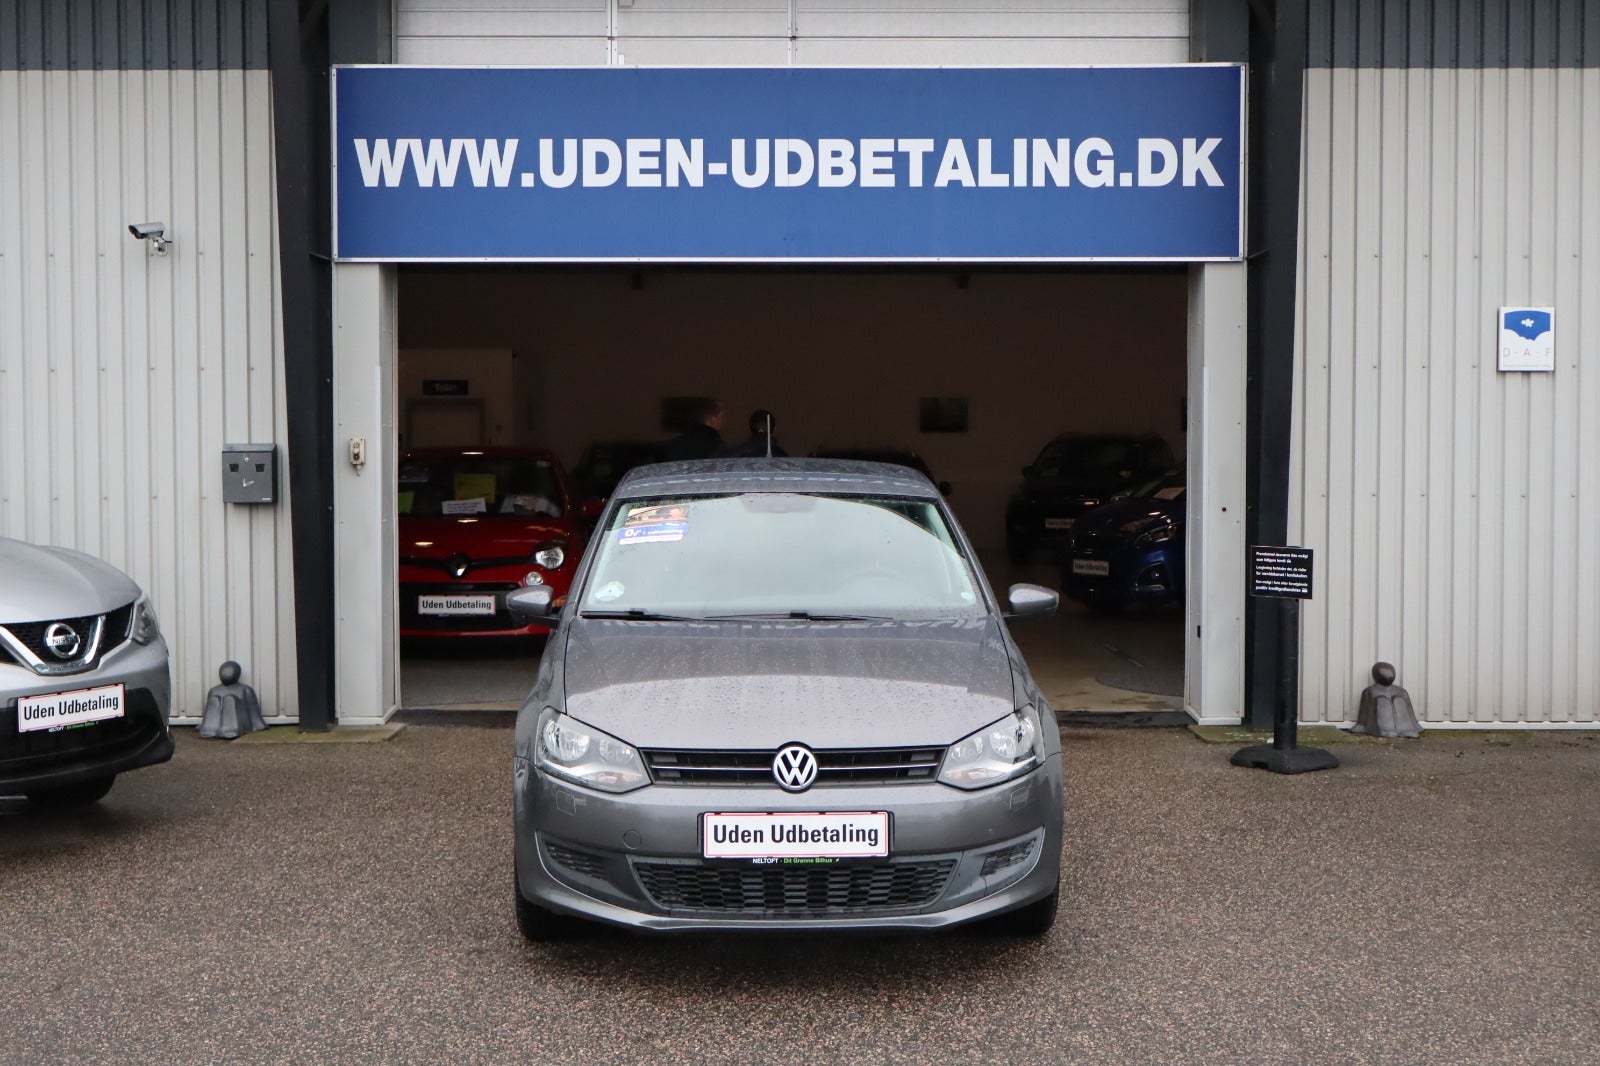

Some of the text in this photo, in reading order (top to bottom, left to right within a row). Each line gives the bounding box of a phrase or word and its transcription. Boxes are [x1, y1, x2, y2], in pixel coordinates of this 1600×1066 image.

[353, 137, 1225, 189] WWW.UDEN-UDBETALING.DK
[422, 600, 492, 610] Uden Udbetaling
[24, 695, 119, 720] Uden Udbetaling
[714, 823, 879, 847] Uden Udbetaling
